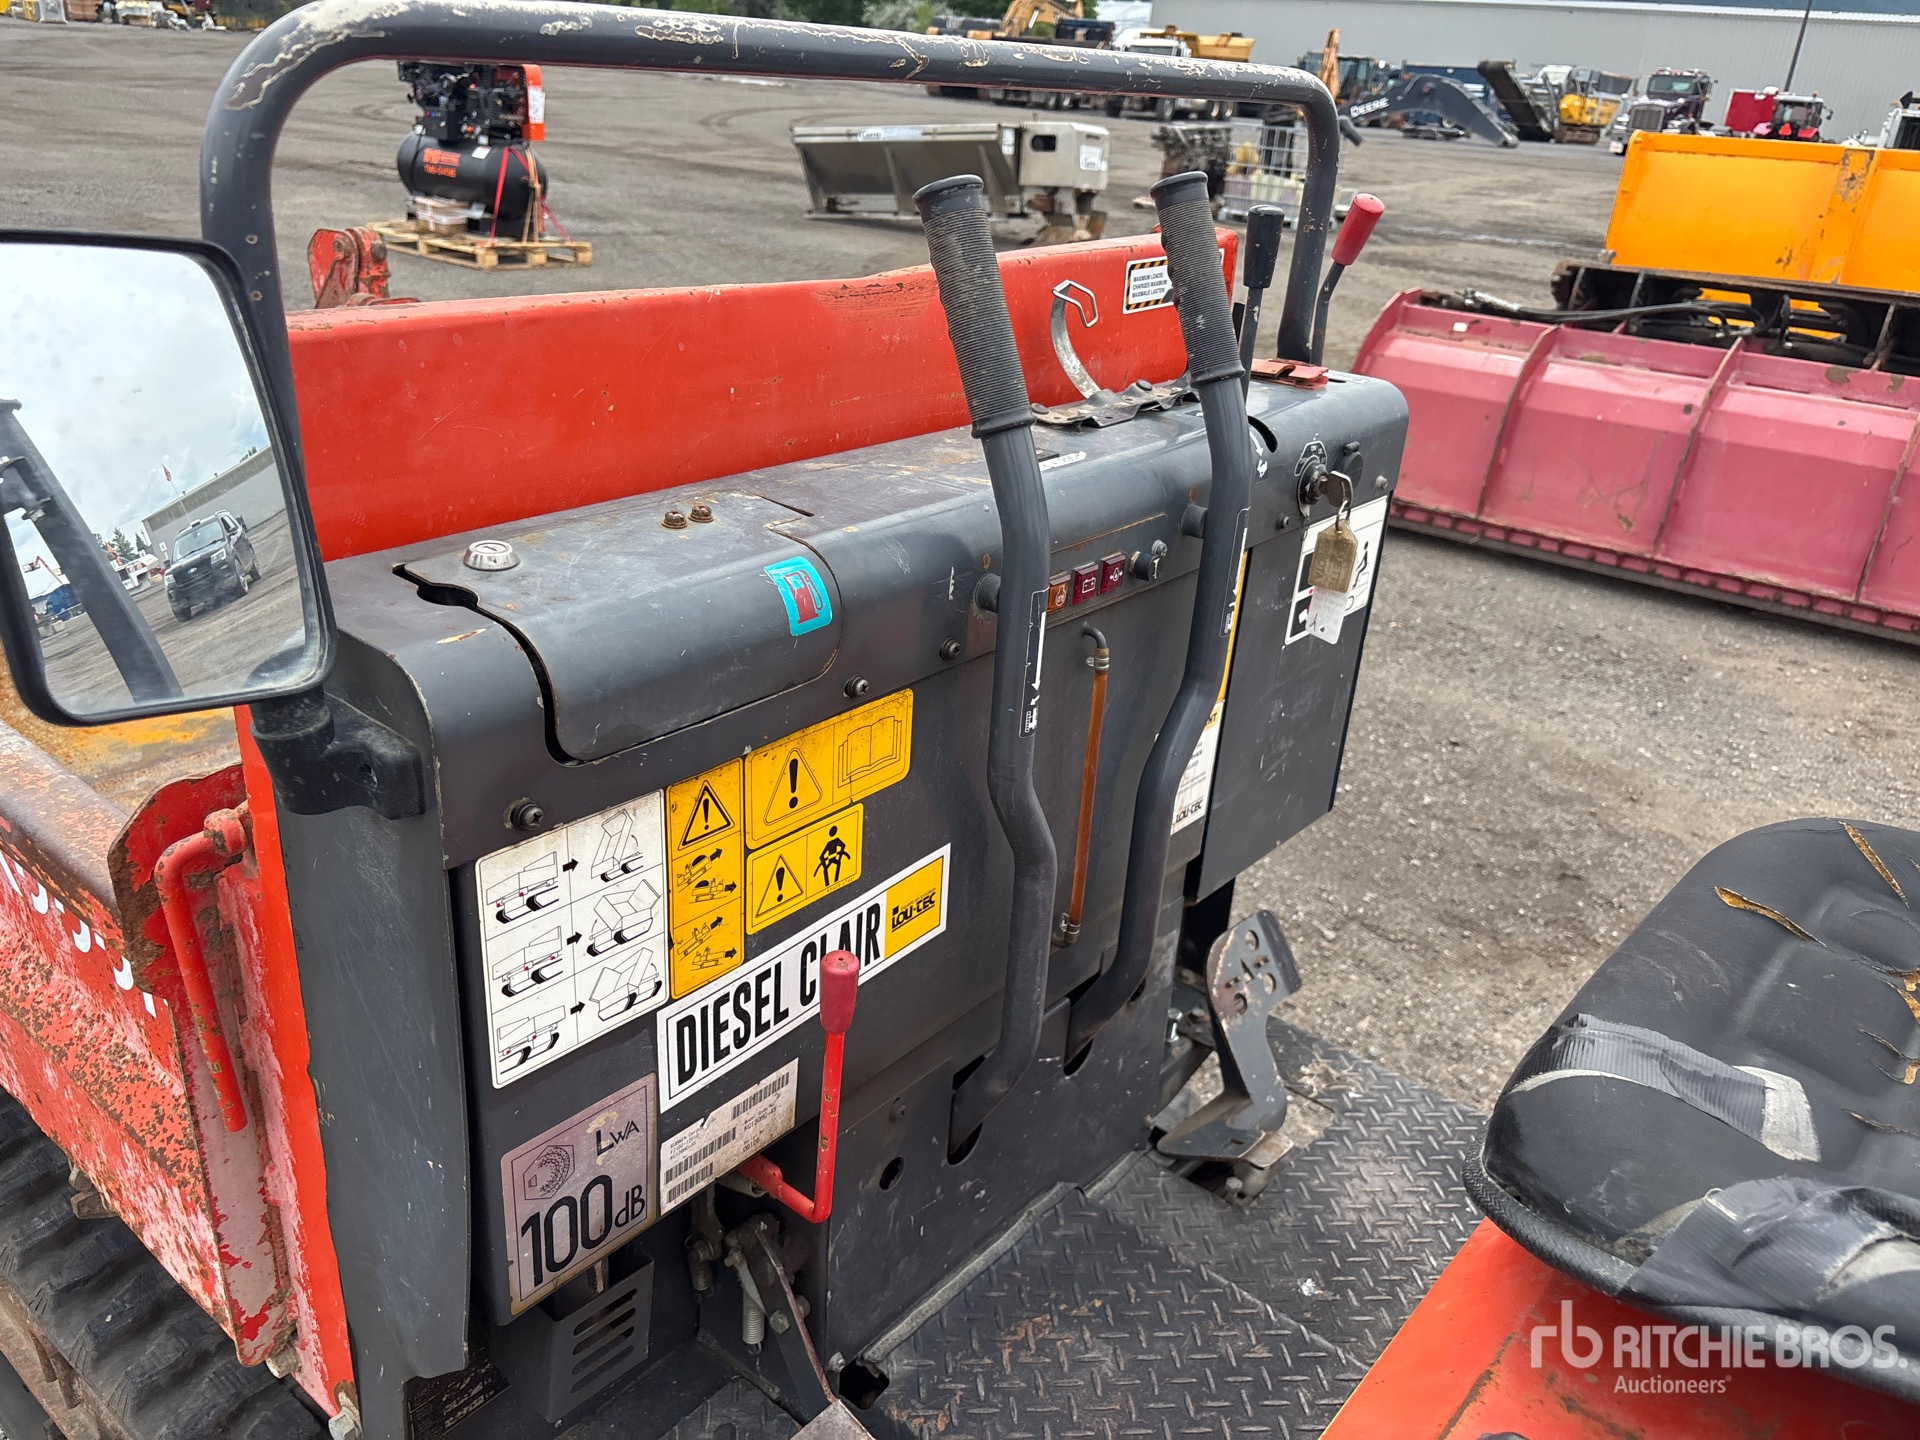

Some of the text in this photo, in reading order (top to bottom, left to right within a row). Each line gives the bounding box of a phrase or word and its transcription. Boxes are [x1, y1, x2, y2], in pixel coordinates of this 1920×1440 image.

[1350, 97, 1389, 118] DEERE
[1133, 274, 1150, 282] MAXIMUM
[1132, 282, 1150, 290] CHARGES
[676, 961, 789, 1087] DIESEL
